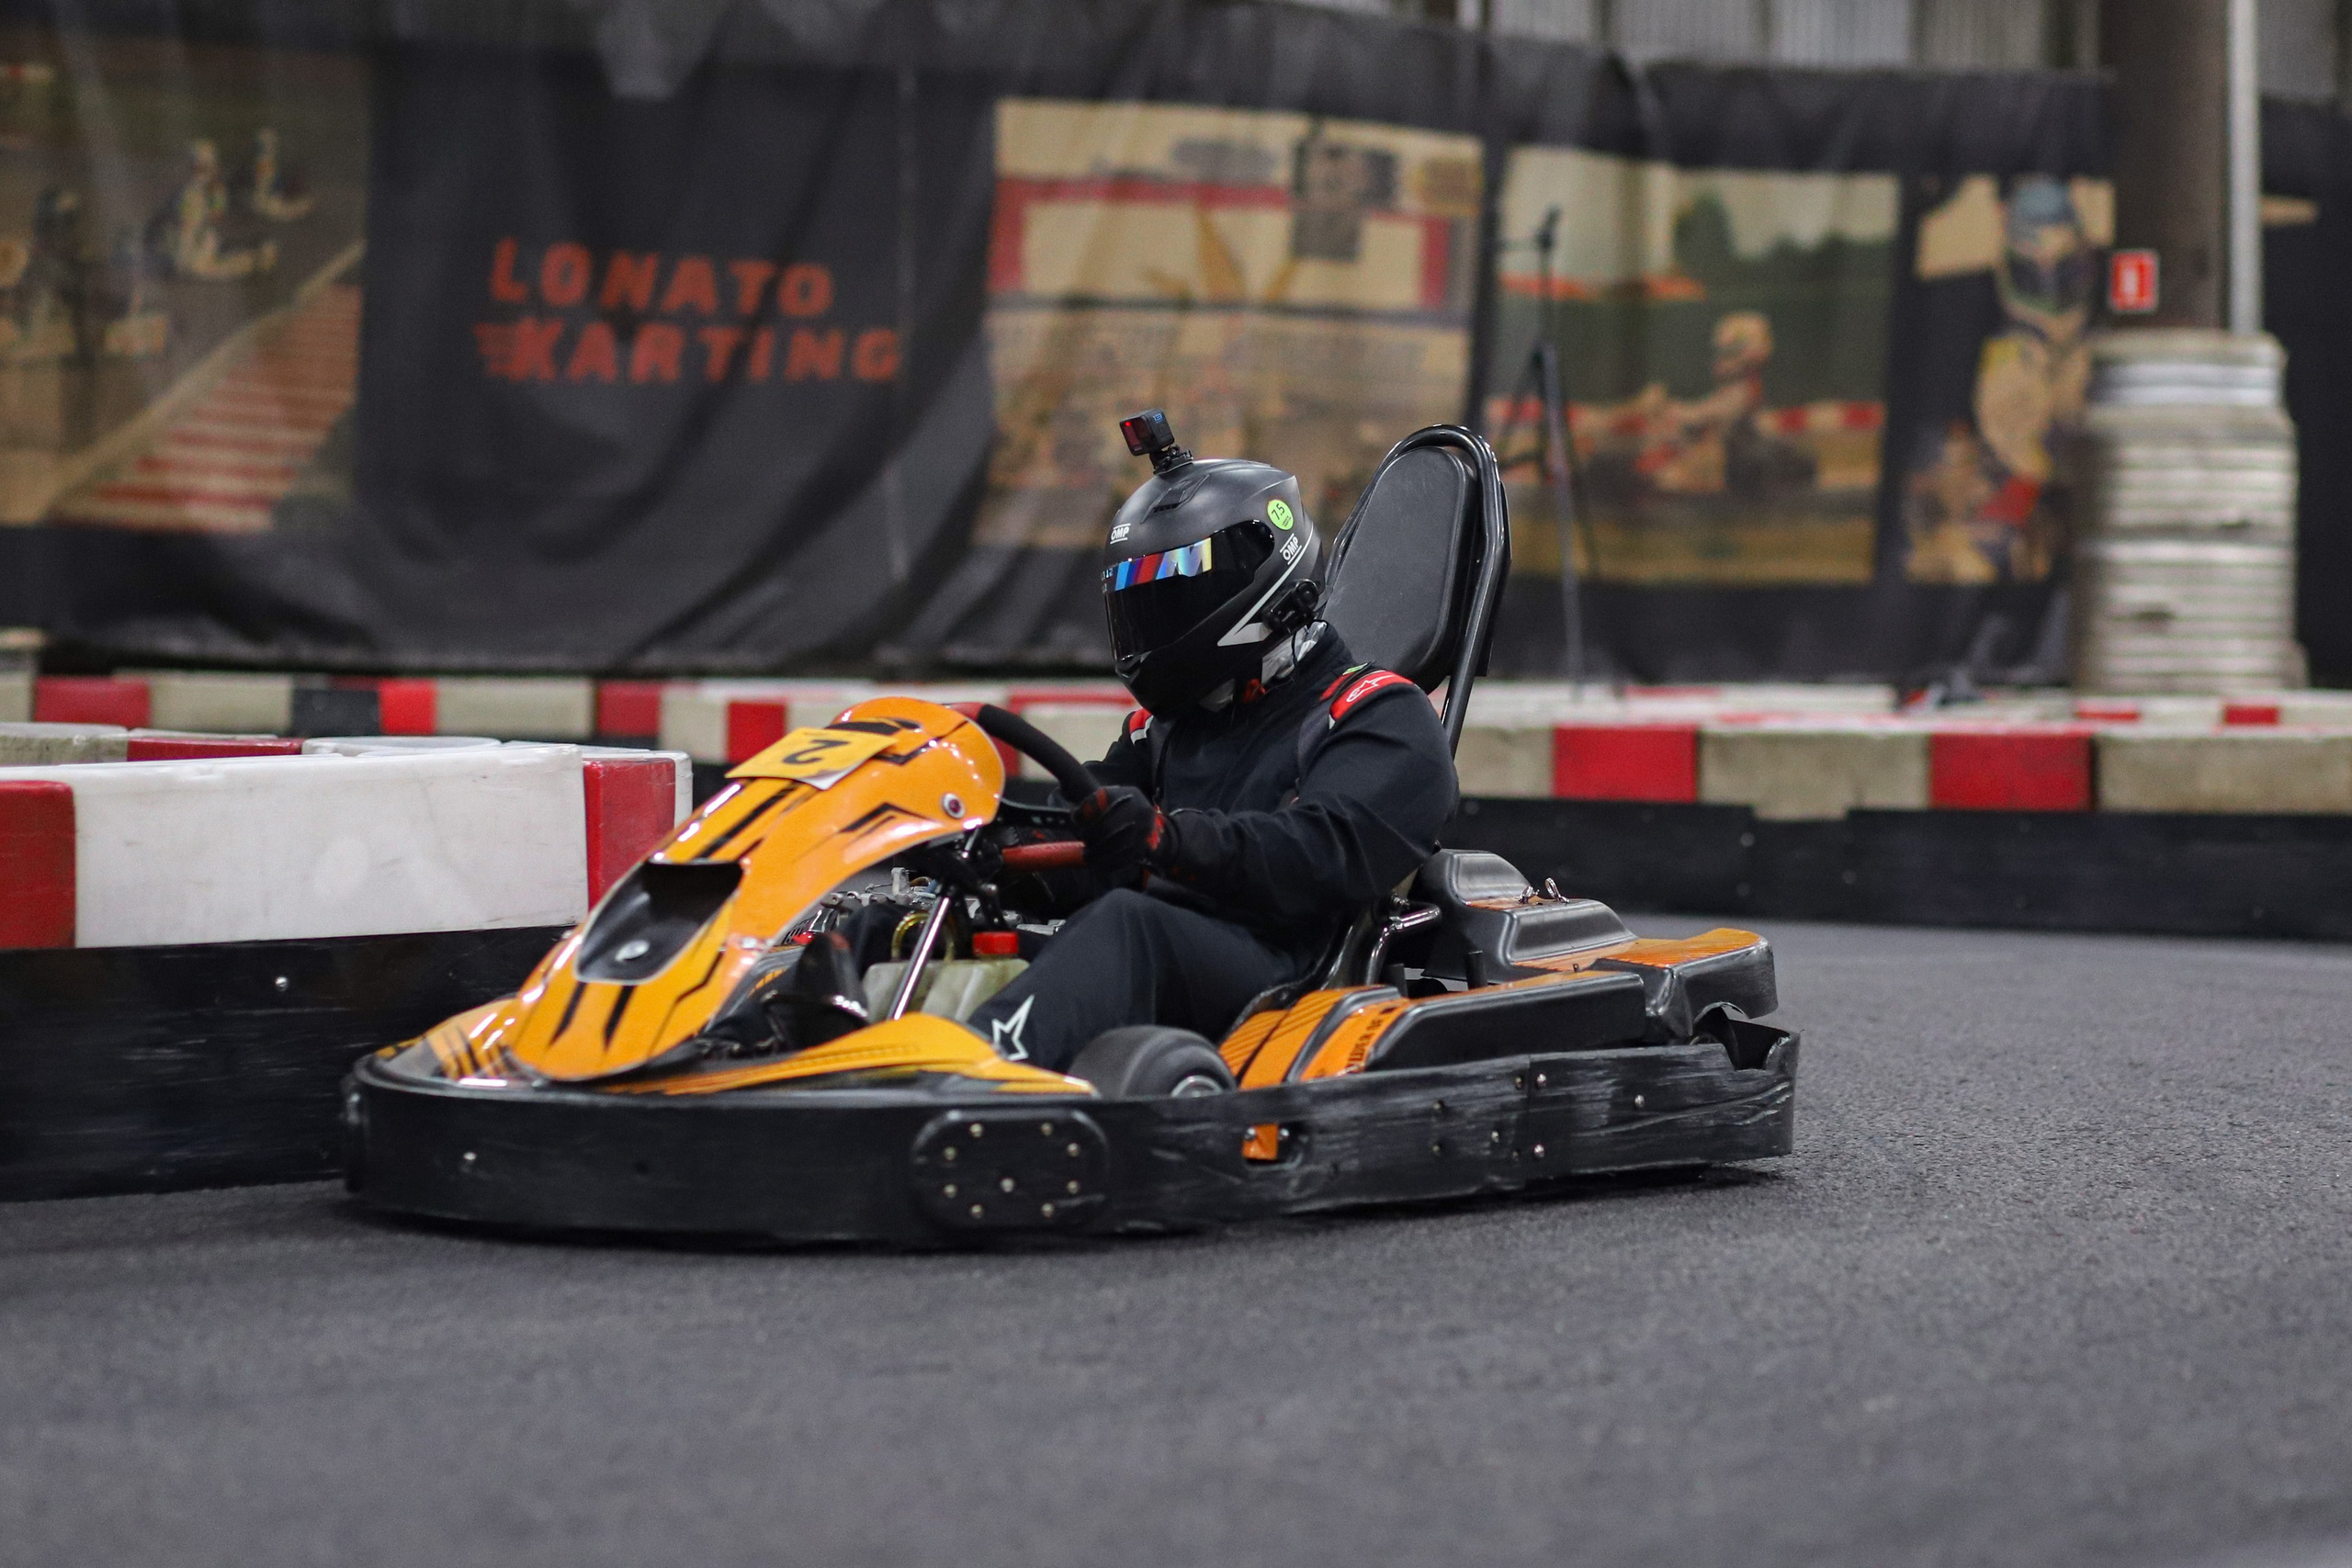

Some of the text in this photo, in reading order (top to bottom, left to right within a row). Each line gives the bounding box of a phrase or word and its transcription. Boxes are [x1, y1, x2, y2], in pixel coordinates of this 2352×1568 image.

[489, 236, 832, 317] LONATO
[503, 317, 900, 382] KARTING
[1111, 526, 1130, 540] OMP
[1283, 536, 1299, 560] OMP
[783, 739, 851, 764] 2
